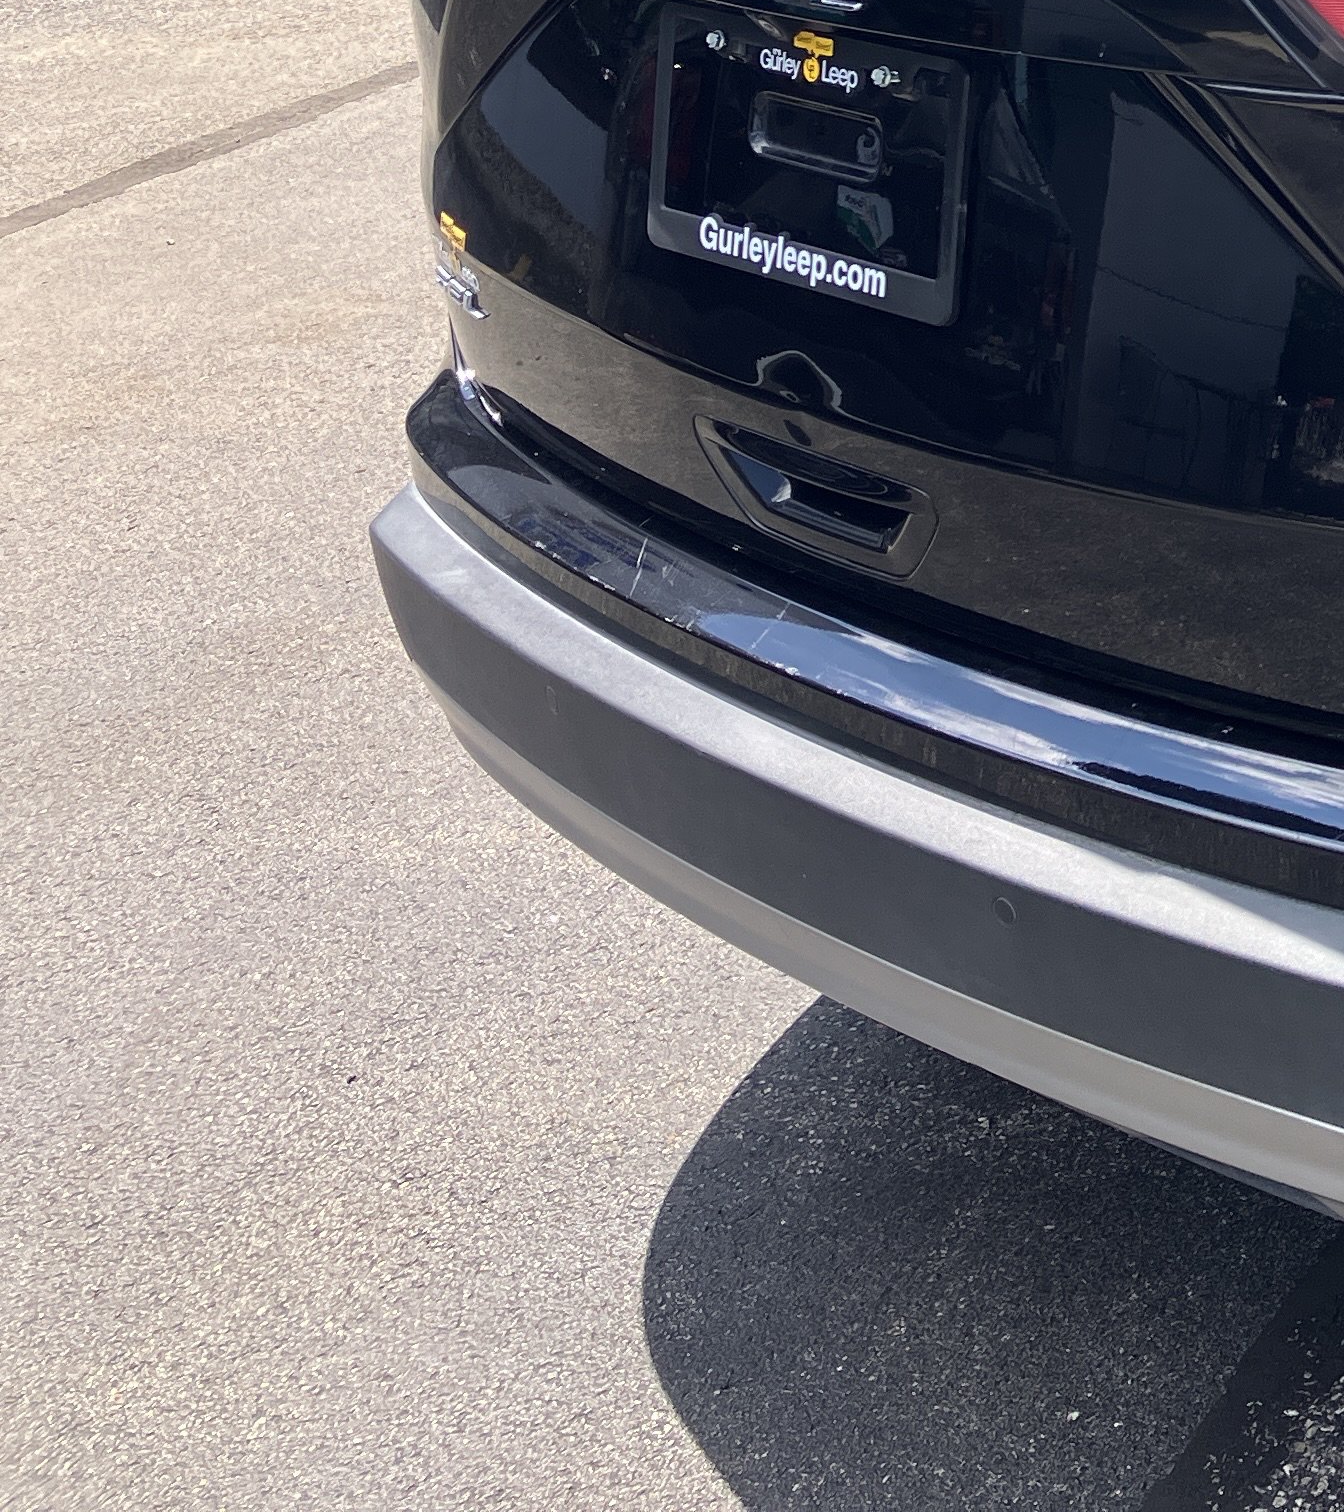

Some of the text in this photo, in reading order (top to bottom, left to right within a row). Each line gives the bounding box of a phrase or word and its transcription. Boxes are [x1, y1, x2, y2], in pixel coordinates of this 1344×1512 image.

[760, 48, 802, 80] Gurley
[821, 60, 859, 93] Leep
[699, 216, 887, 298] Gurleyleep.com
